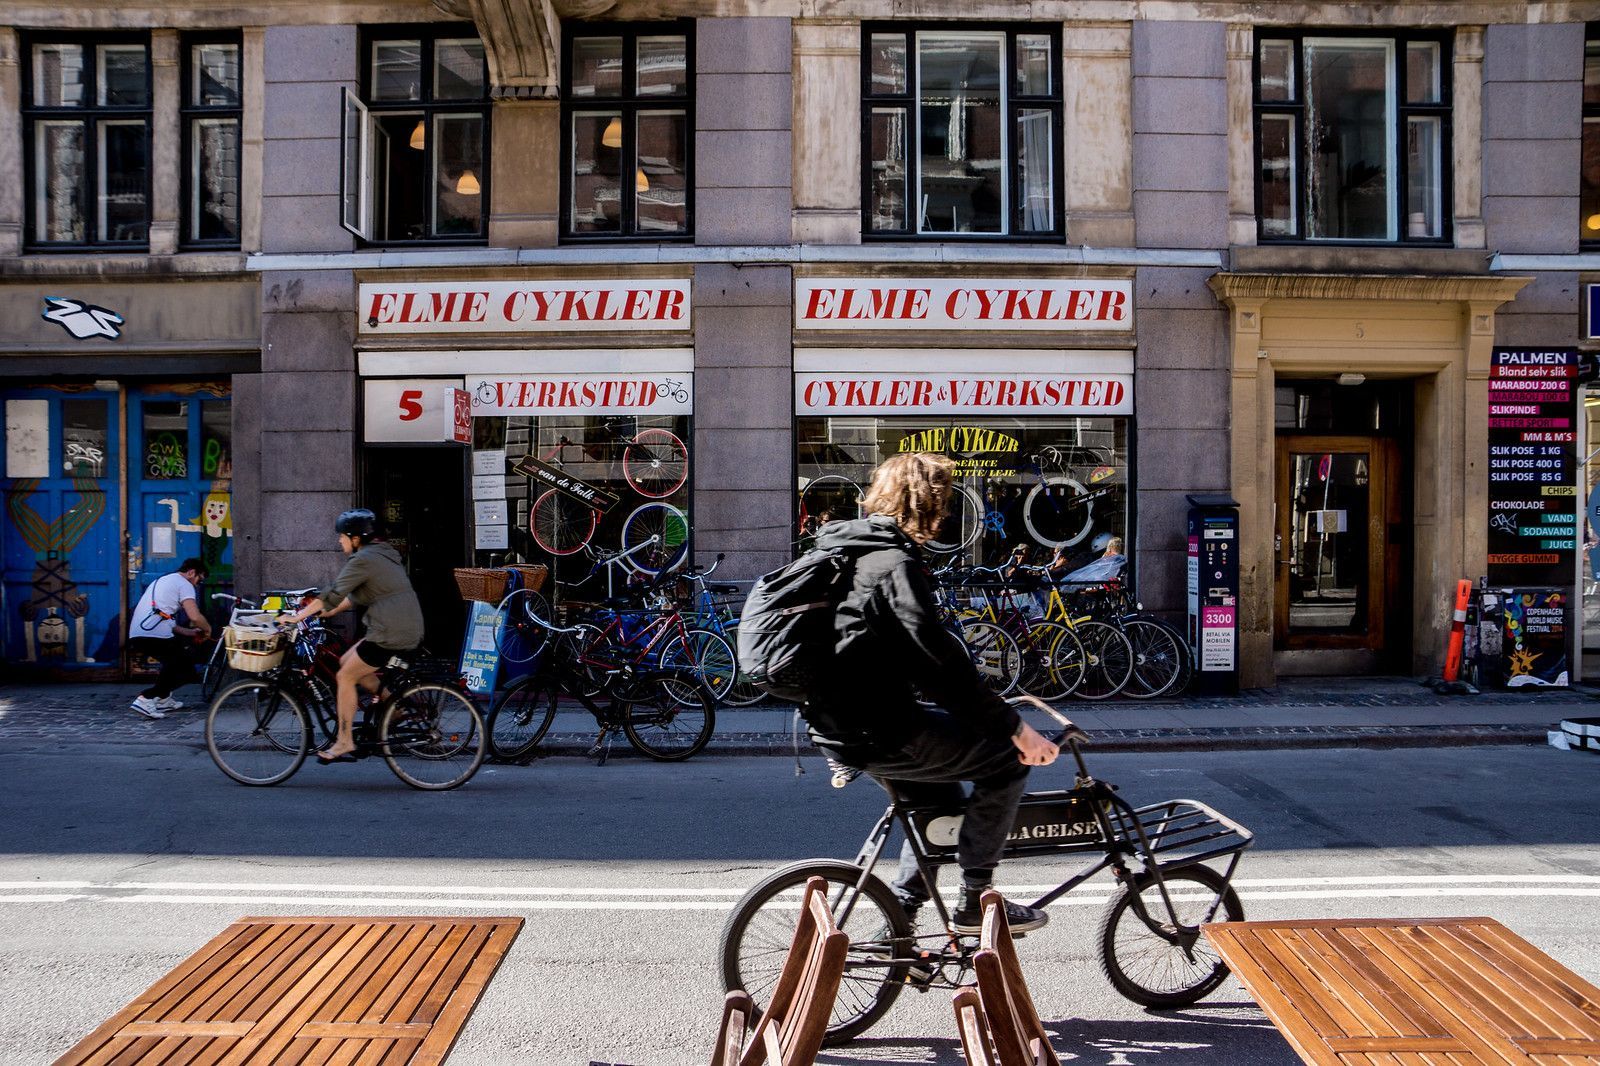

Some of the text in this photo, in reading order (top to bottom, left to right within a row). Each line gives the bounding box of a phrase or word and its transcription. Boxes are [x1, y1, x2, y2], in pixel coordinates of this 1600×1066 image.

[363, 289, 686, 323] ELME CYKLER
[802, 288, 1127, 321] ELME CYKLER
[1355, 321, 1365, 338] 5
[1499, 352, 1567, 364] PALMEN
[1499, 366, 1567, 377] Bland selv slik
[1491, 381, 1567, 390] MARABOU 200 G
[494, 380, 657, 408] VÆRKSTED
[398, 390, 423, 421] 5
[1491, 405, 1537, 414] SLIKPINDE
[898, 426, 1019, 453] ELME CYKLER
[1523, 433, 1542, 441] MM
[1544, 433, 1553, 441] &
[1491, 447, 1510, 455] SLIK
[1511, 447, 1534, 455] POSE
[1549, 447, 1561, 455] KG
[955, 459, 998, 467] SERVICE
[1491, 459, 1561, 468] SLIK POSE 400 G
[989, 469, 1016, 478] LEJE
[1491, 472, 1562, 481] SLIK POSE 85 G
[1547, 486, 1573, 495] CHIPS
[1491, 501, 1545, 510] CHOKOLADE
[1548, 514, 1574, 523] VAND
[1524, 527, 1574, 536] SODAVAND
[1549, 540, 1573, 549] JUICE
[1491, 555, 1556, 563] TYGGE GUMMI
[1206, 613, 1232, 624] 3300
